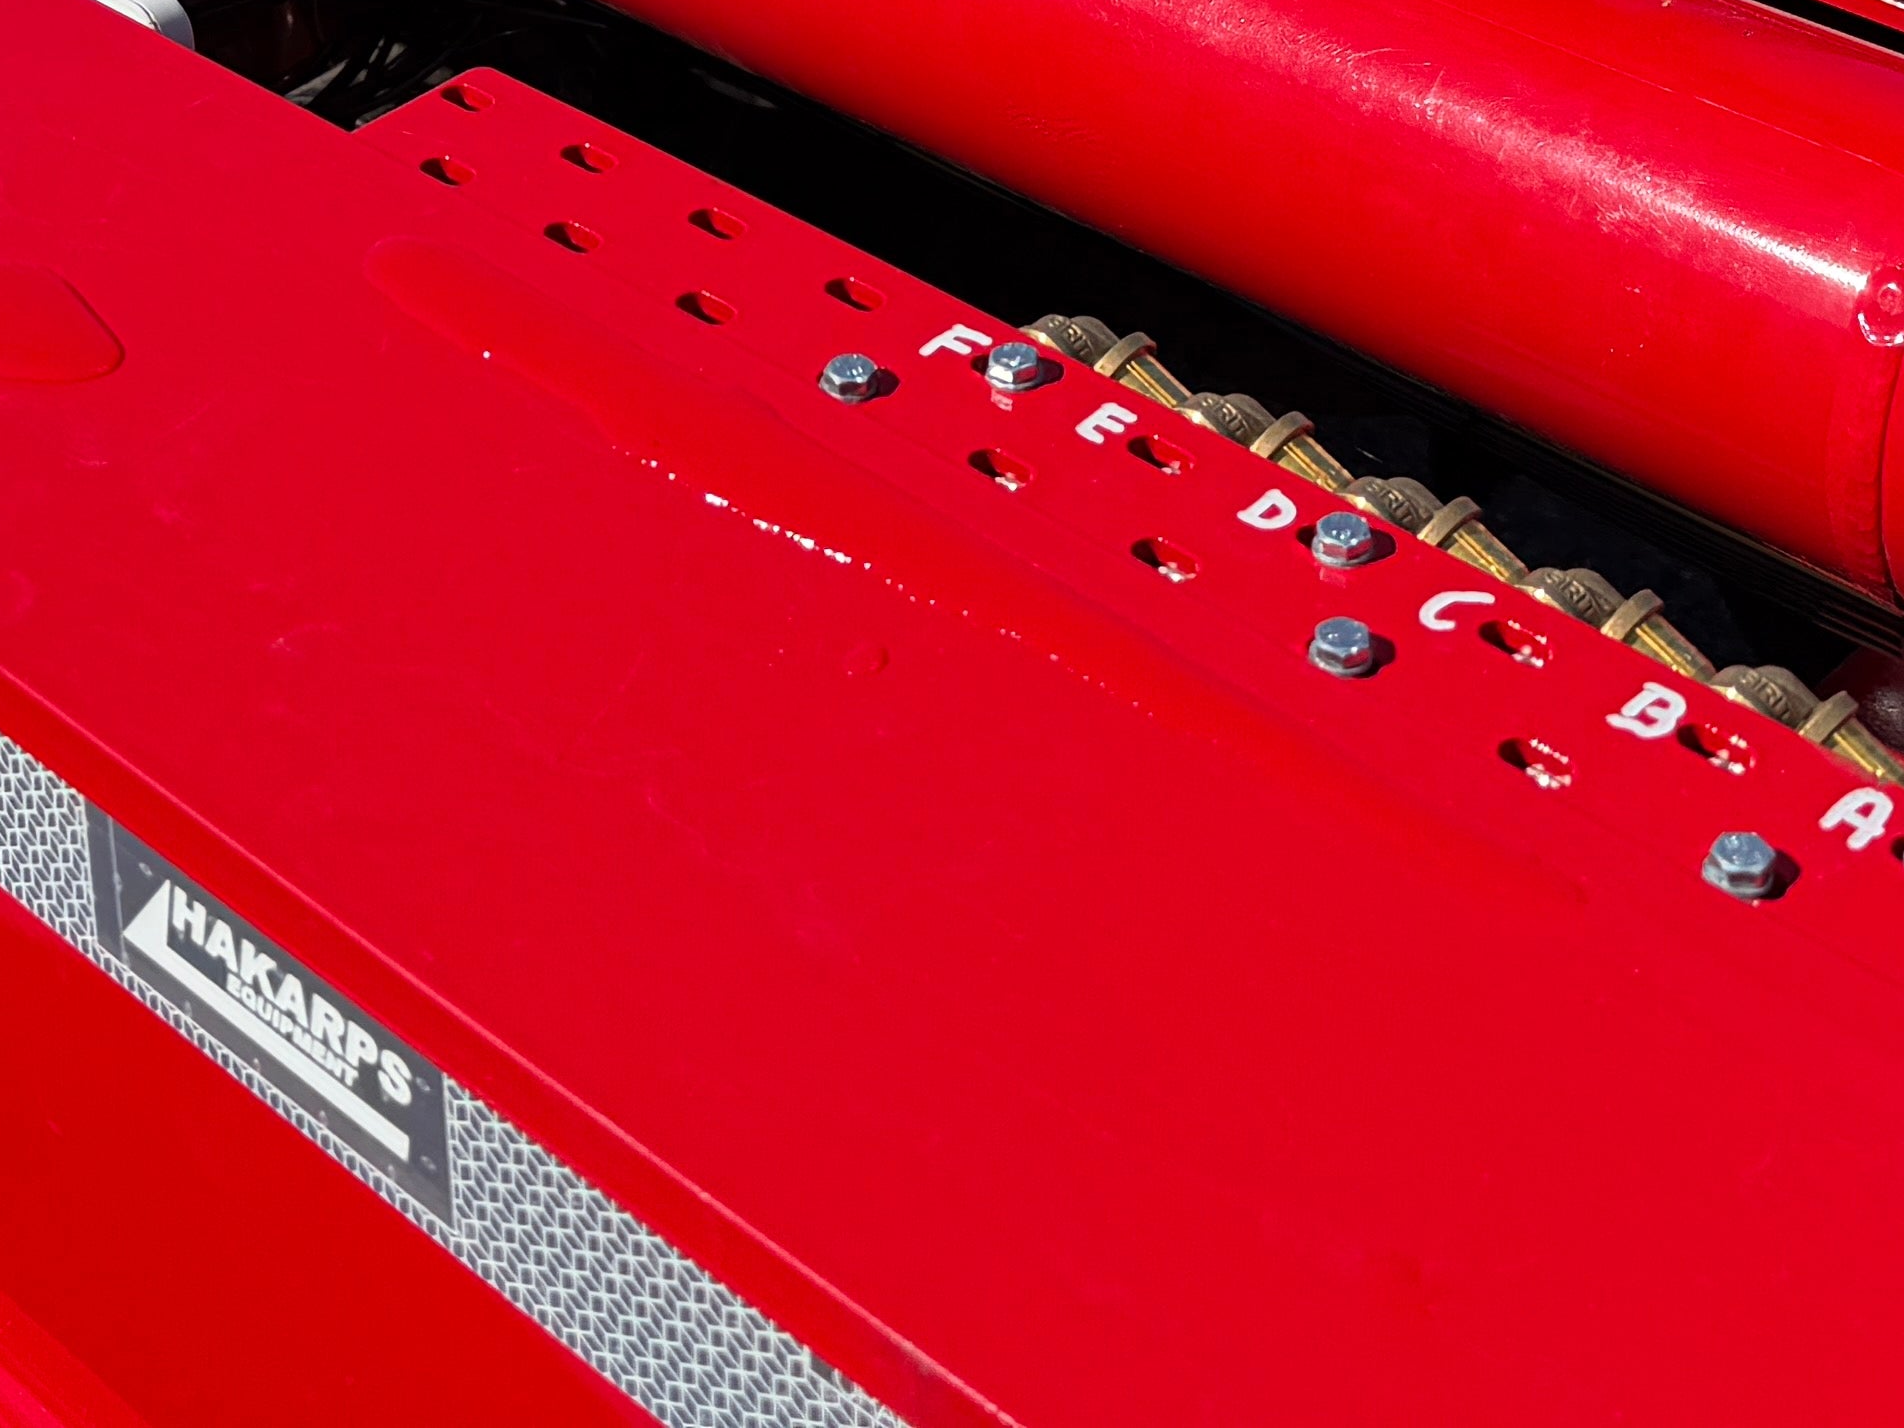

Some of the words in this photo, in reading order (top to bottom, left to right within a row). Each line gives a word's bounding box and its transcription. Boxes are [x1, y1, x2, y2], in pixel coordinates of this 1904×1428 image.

[918, 323, 993, 357] F
[1074, 402, 1138, 445] E
[1236, 488, 1297, 530] D
[1418, 590, 1496, 631] C
[1605, 681, 1687, 739] B
[1819, 787, 1894, 850] A
[170, 884, 413, 1106] HAKARPS
[225, 972, 360, 1088] EQUIPMENT
